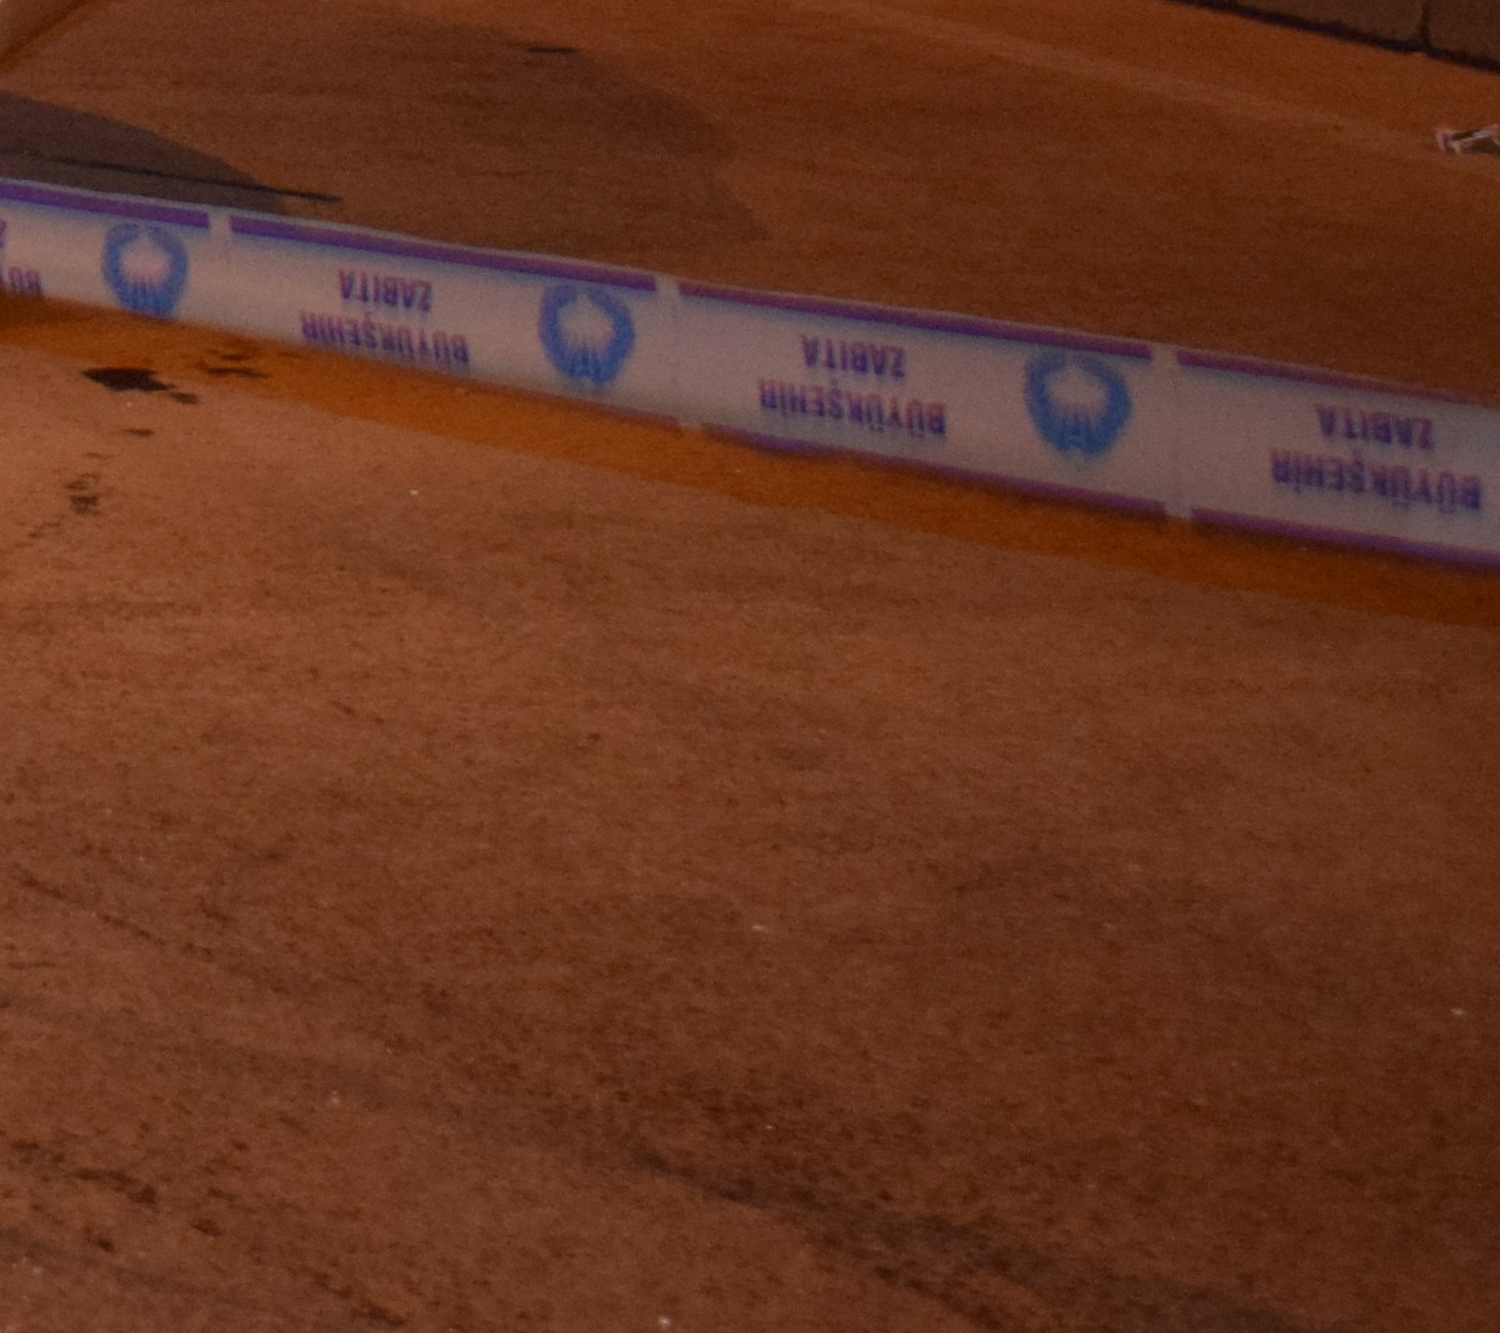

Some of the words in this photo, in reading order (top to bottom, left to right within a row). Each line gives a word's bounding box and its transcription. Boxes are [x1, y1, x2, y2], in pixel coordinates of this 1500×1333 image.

[337, 270, 433, 315] ZABITA
[801, 336, 907, 385] ZABITA
[1316, 406, 1435, 454] ZABITA
